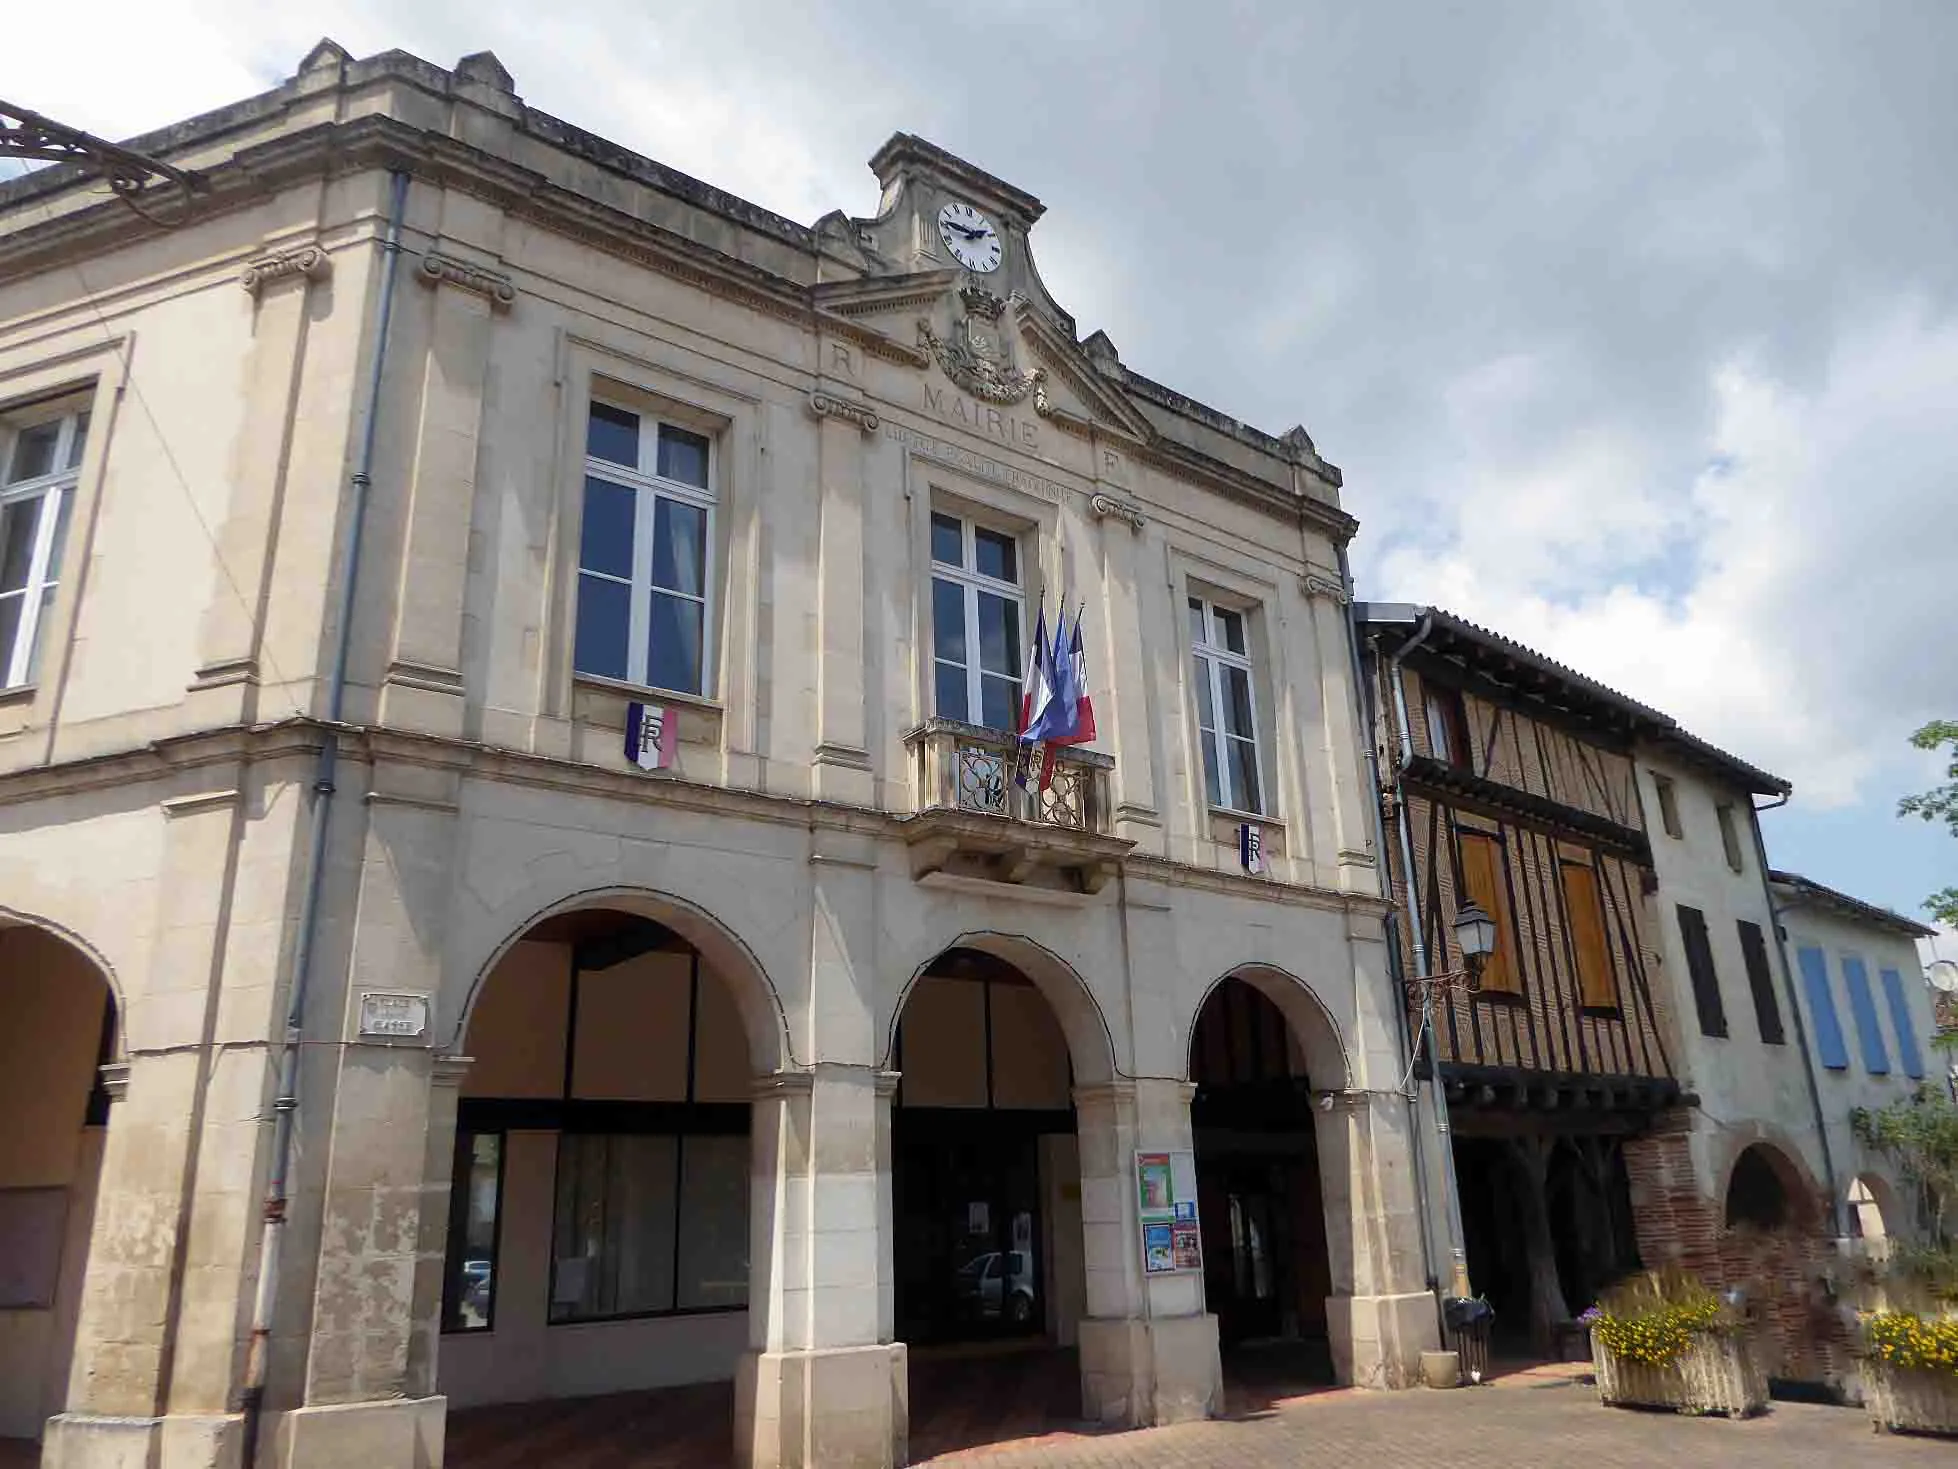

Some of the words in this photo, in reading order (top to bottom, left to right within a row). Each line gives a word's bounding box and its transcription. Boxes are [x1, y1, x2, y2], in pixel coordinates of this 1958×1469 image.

[831, 343, 855, 377] R
[922, 383, 1040, 449] MAIRIE
[1103, 450, 1119, 475] F
